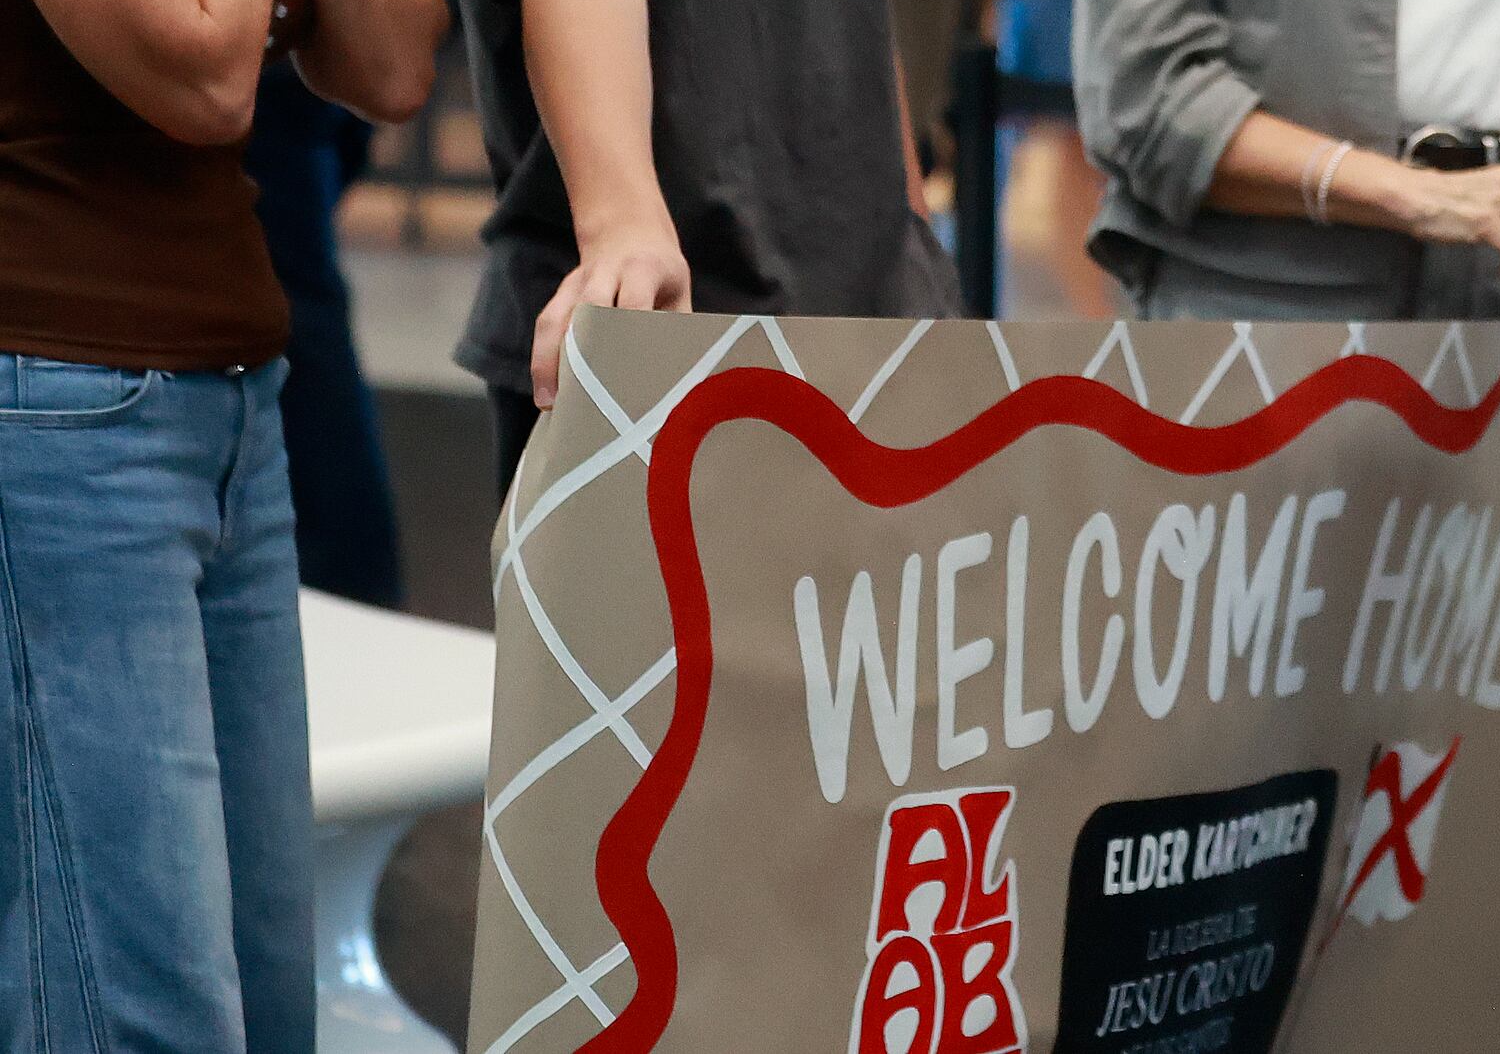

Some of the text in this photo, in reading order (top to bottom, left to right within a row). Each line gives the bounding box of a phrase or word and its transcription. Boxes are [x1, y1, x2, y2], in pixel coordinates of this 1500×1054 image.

[793, 489, 1347, 804] WELCOME
[875, 789, 1014, 944] AL
[1103, 828, 1191, 896] ELDER
